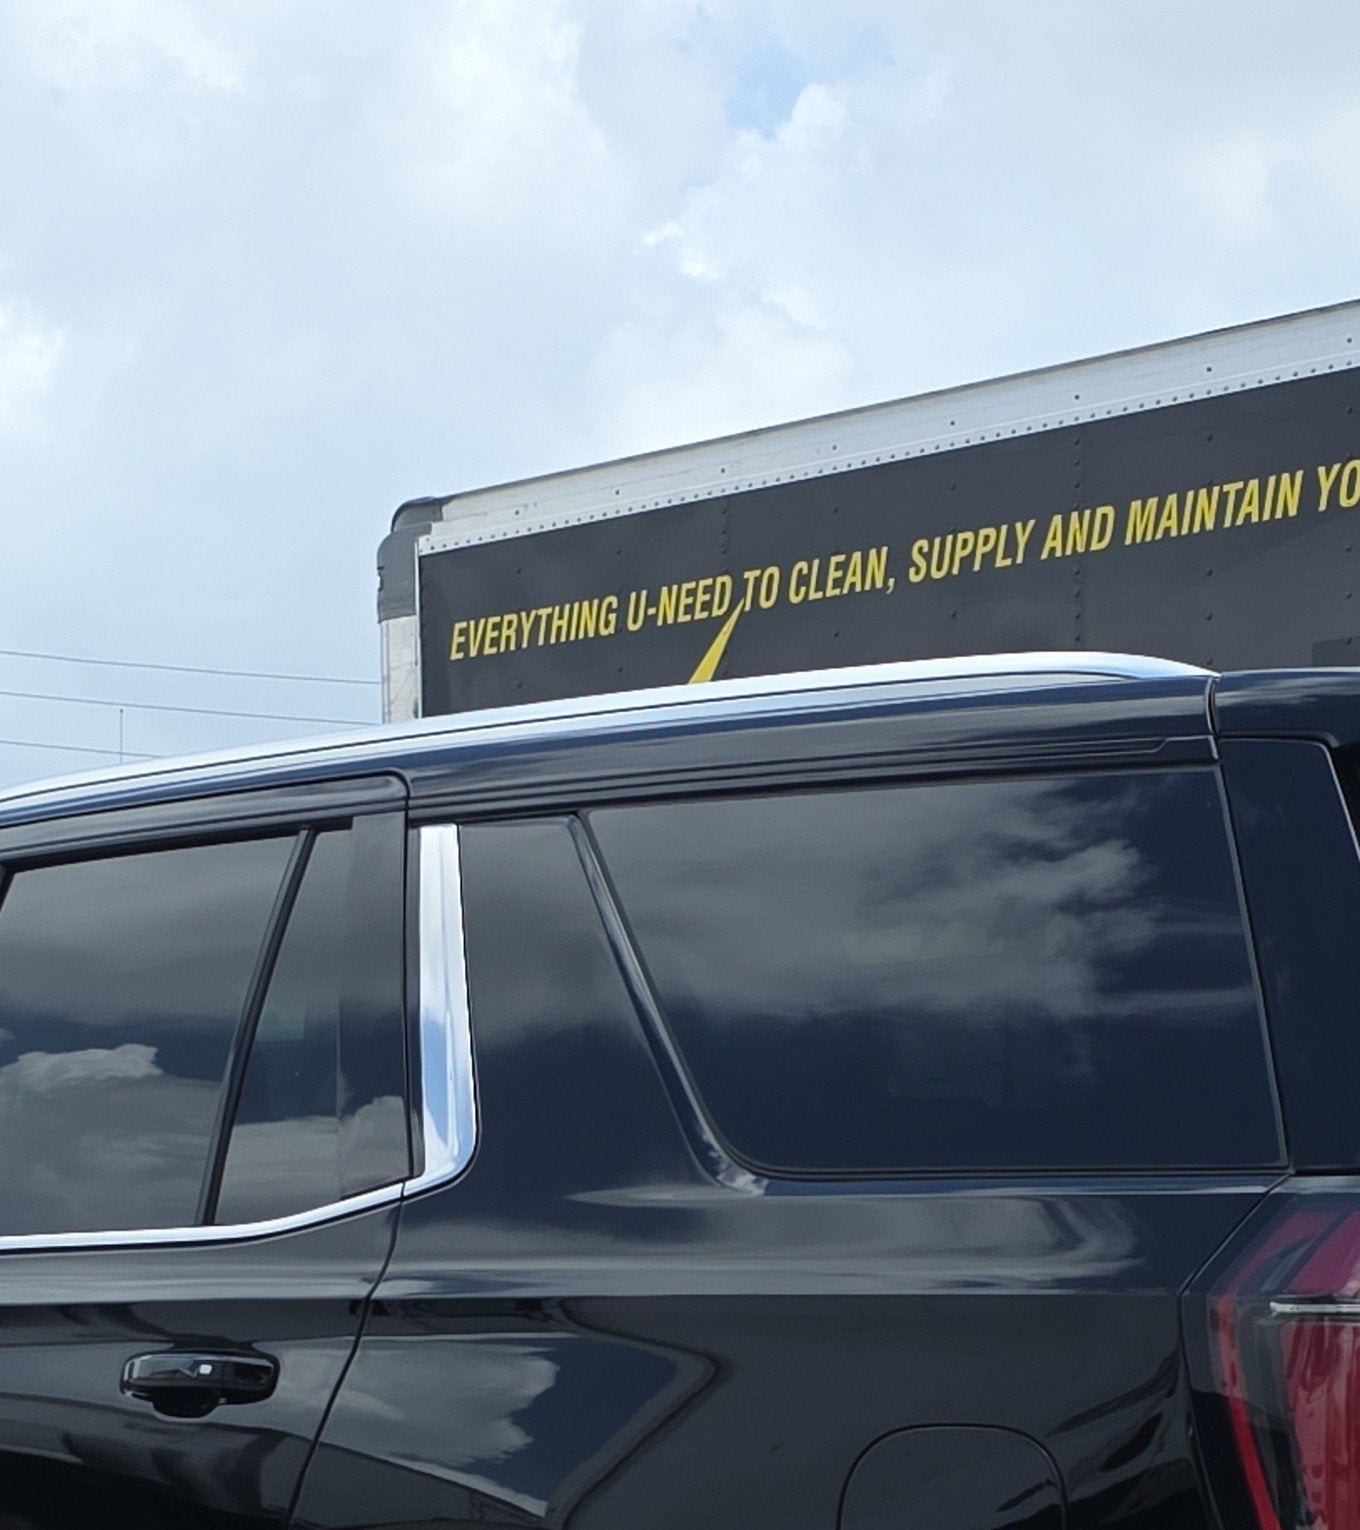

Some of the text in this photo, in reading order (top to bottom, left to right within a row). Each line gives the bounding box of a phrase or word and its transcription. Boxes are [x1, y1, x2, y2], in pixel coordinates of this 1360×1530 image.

[450, 595, 619, 660] EVERYTHING
[627, 576, 732, 632] U-NEED
[744, 566, 781, 610] TO
[788, 547, 896, 605] CLEAN,
[907, 519, 1035, 584] SUPPLY
[1040, 505, 1116, 561] AND
[1124, 469, 1304, 546] MAINTAIN
